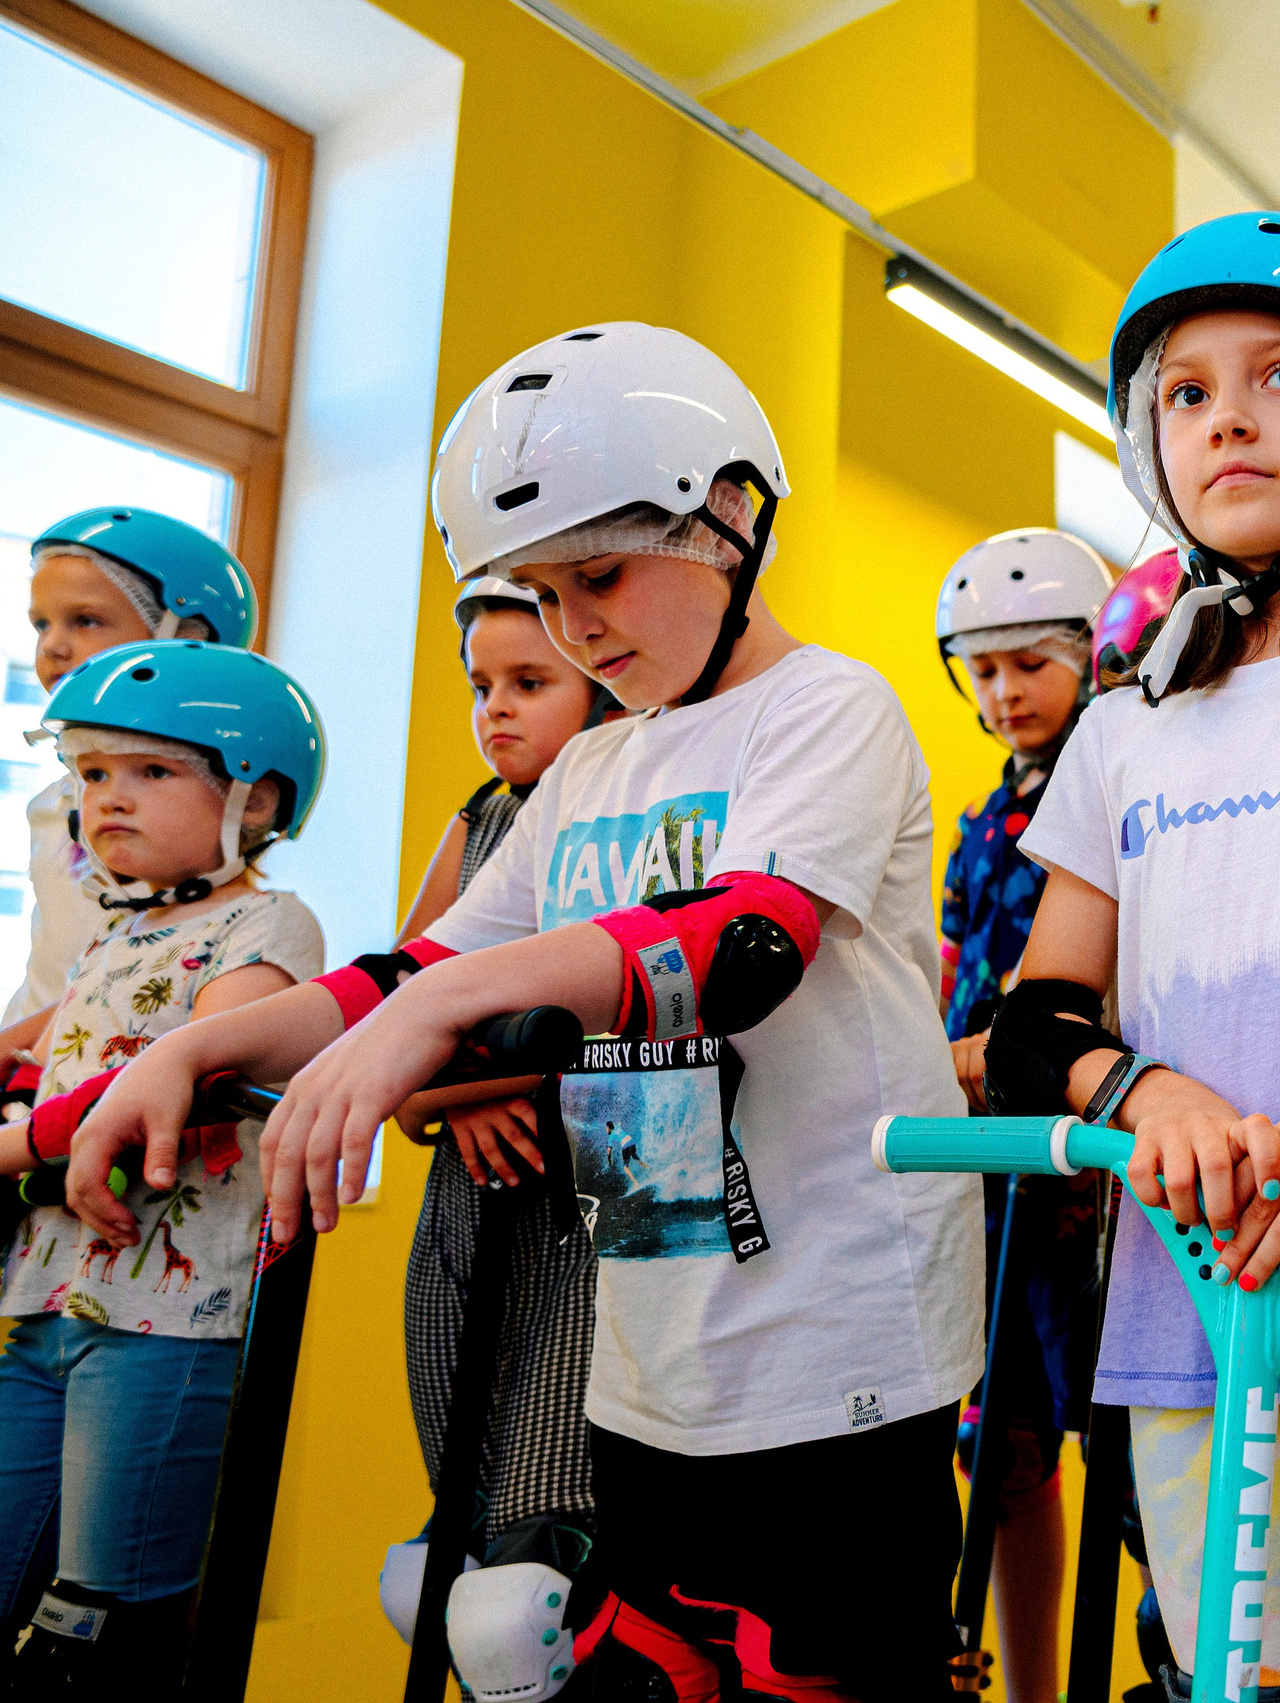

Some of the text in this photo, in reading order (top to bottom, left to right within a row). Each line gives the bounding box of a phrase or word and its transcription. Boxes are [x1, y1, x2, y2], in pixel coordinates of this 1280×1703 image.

[639, 1040, 674, 1067] GUY
[851, 1413, 884, 1428] ADVENTURE
[854, 1407, 880, 1419] SUMMER
